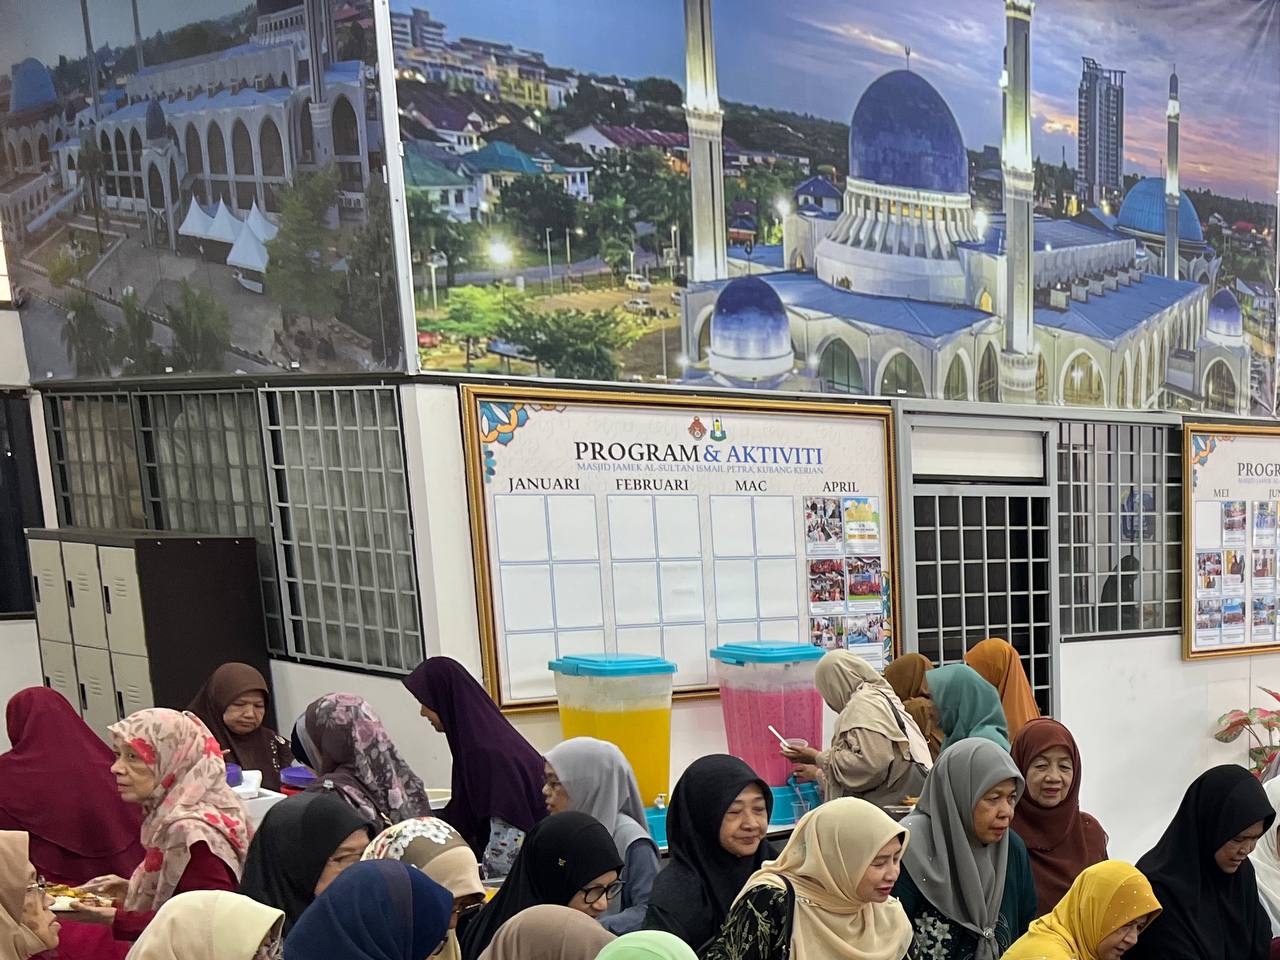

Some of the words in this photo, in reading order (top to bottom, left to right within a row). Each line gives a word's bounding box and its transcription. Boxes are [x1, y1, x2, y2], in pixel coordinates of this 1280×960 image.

[574, 441, 700, 462] PROGRAM
[703, 444, 721, 462] &
[726, 445, 823, 465] AKTIVITI
[577, 463, 611, 473] MASJID
[613, 463, 643, 473] JAMEK
[696, 464, 726, 473] ISMAIL
[757, 466, 793, 475] KUBANG
[508, 477, 580, 493] JANUARI
[616, 478, 689, 491] FEBRUARI
[735, 479, 768, 492] MAC
[823, 481, 859, 493] APRIL
[1213, 488, 1230, 498] MEI
